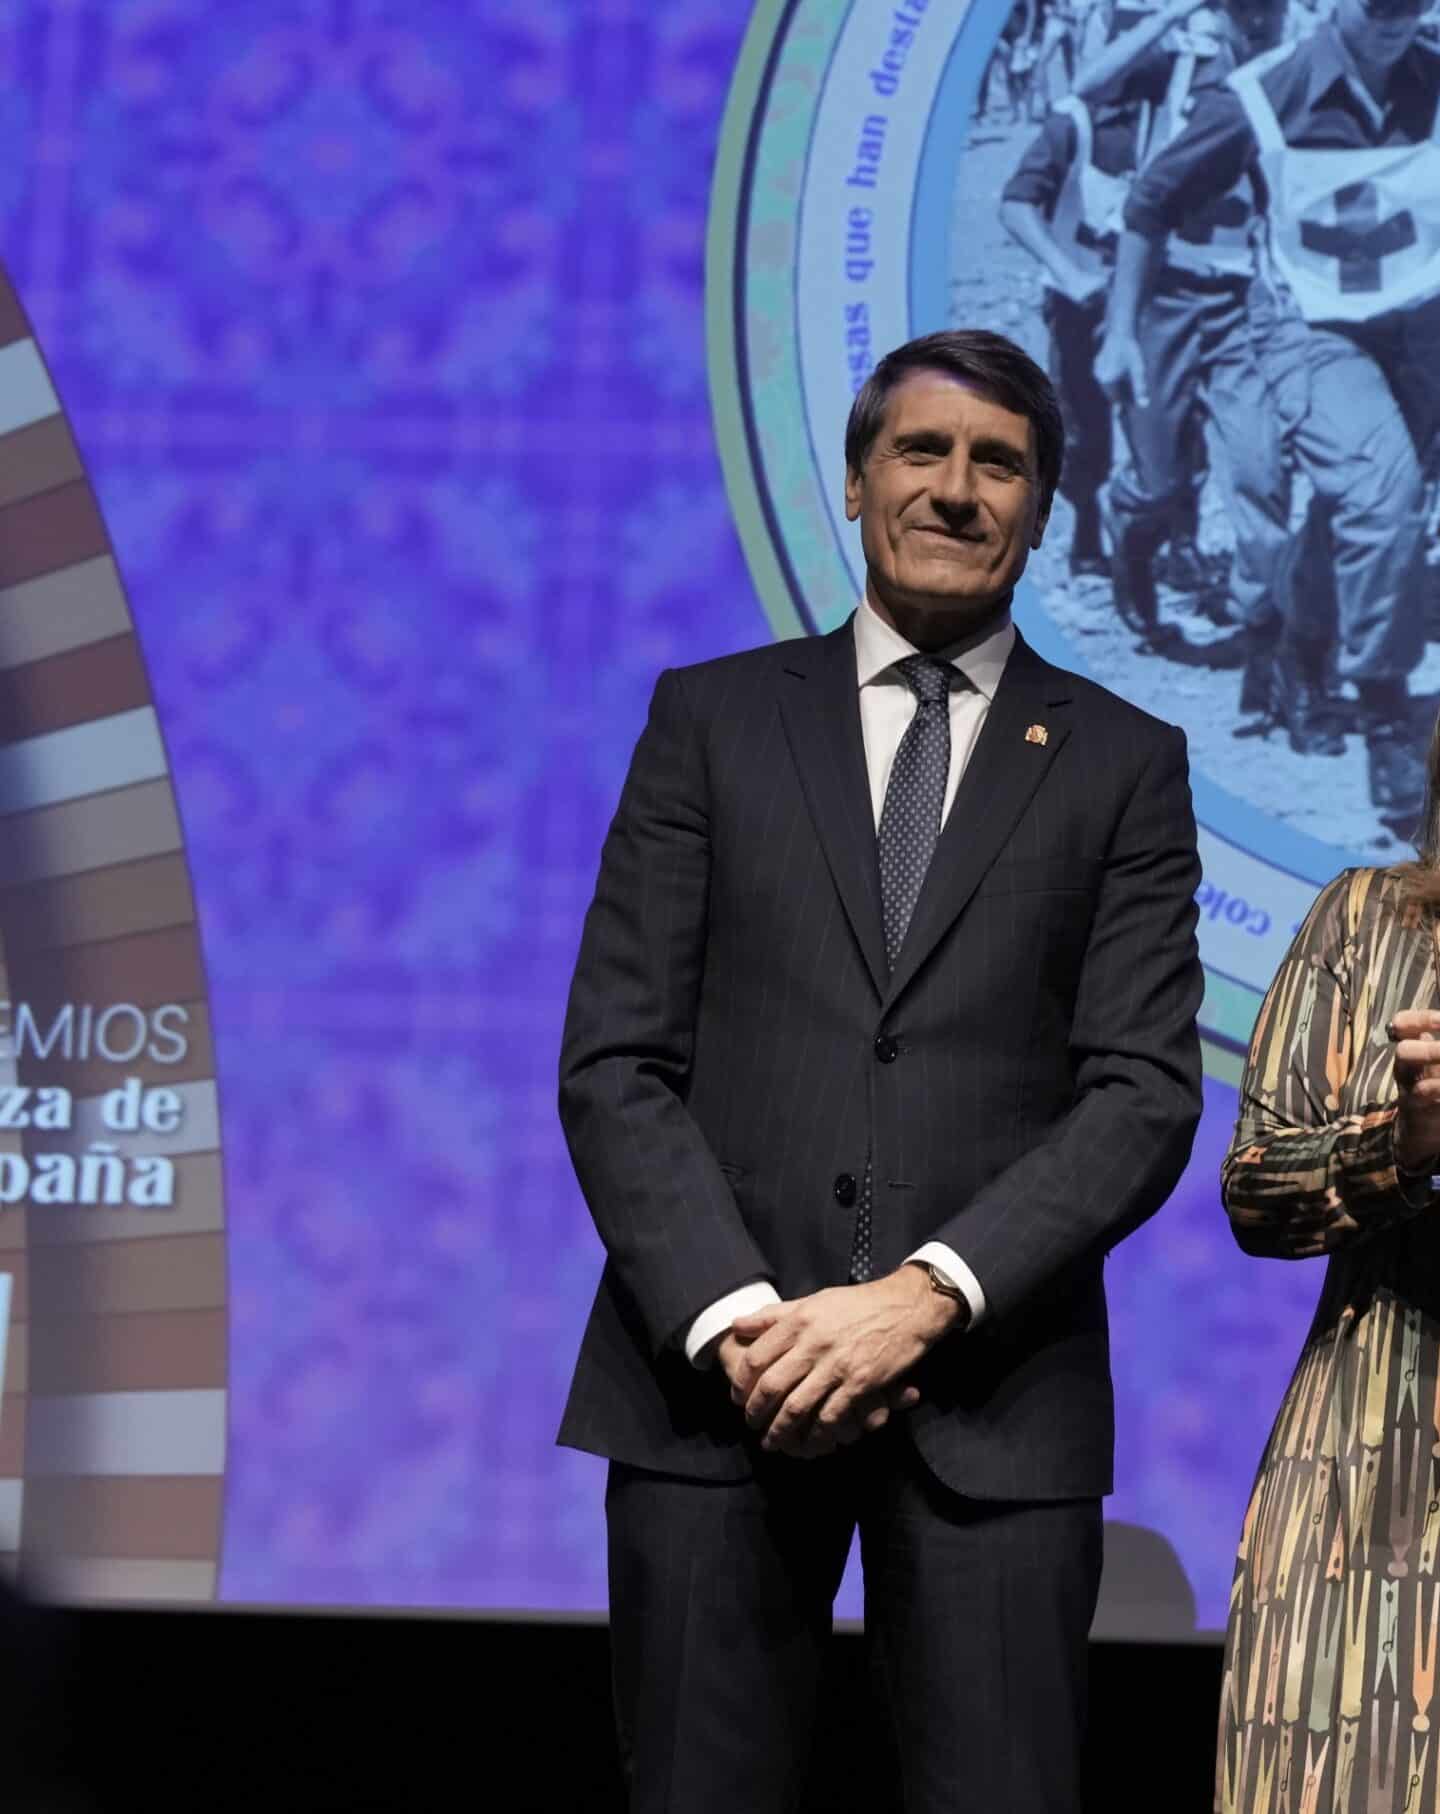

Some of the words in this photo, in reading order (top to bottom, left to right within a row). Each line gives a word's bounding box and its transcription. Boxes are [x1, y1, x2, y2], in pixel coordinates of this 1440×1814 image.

[846, 115, 888, 189] han
[844, 208, 874, 282] que
[102, 1077, 182, 1132] de
